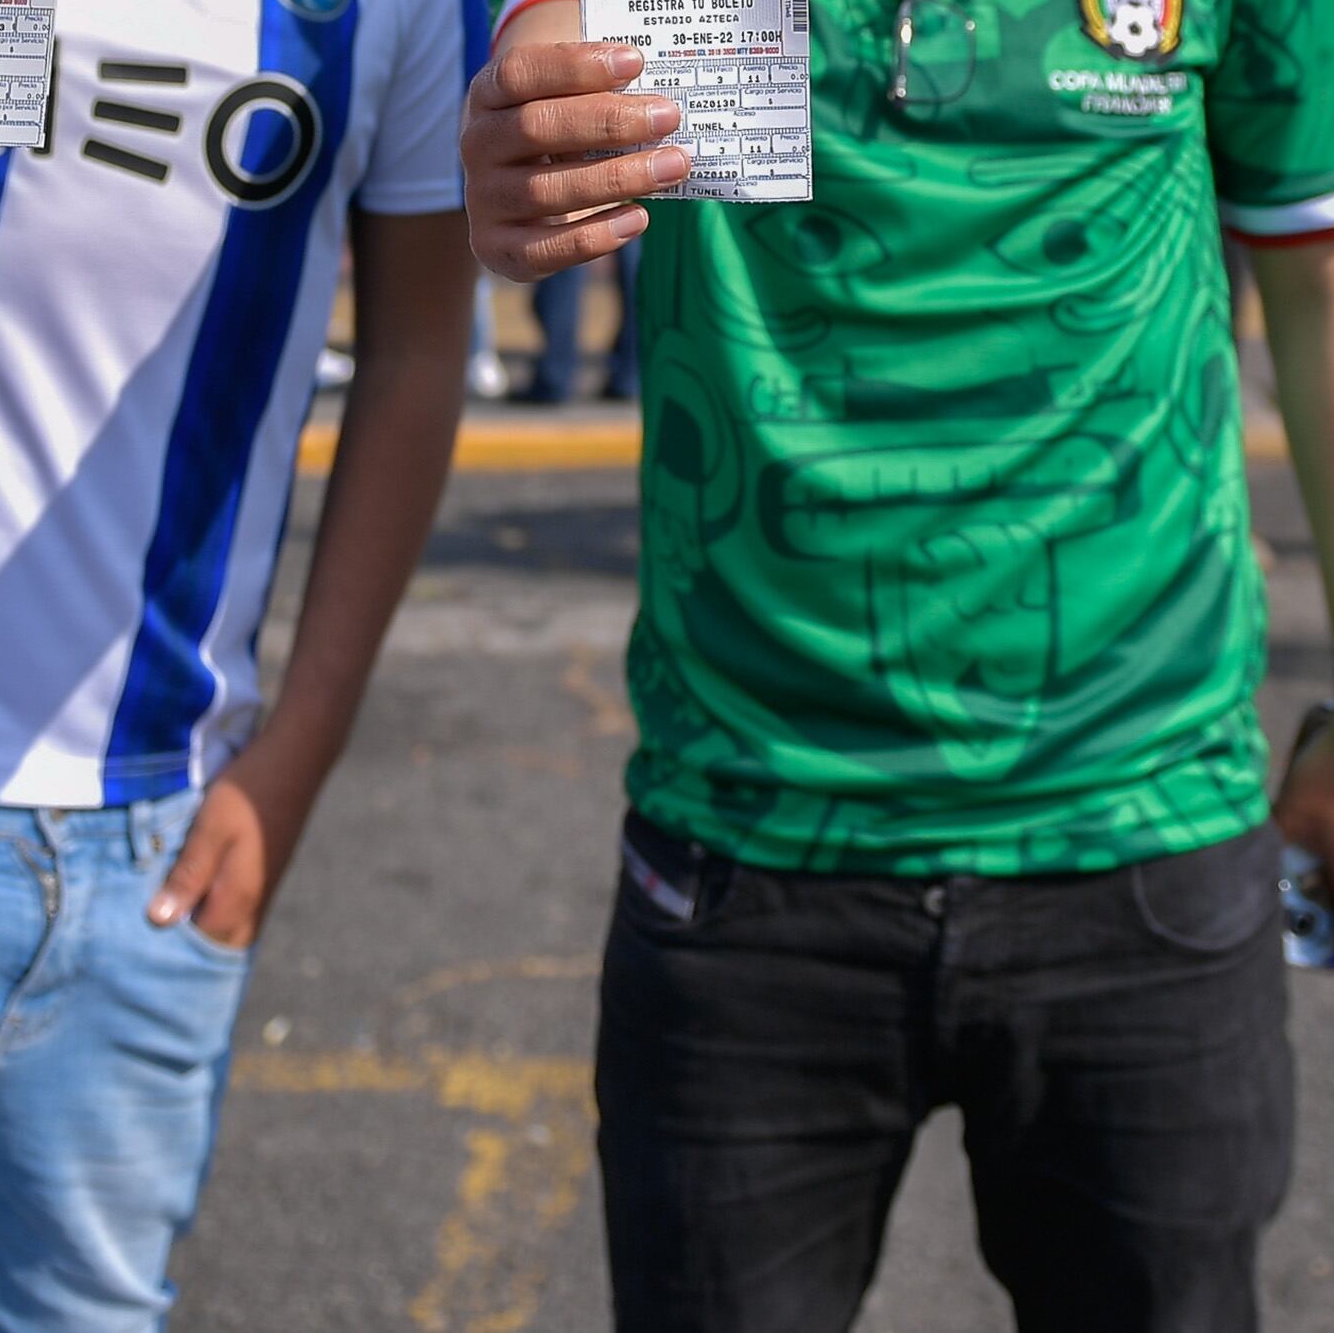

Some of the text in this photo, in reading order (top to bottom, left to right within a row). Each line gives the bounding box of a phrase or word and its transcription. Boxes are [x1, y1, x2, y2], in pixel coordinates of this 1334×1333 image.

[643, 14, 739, 26] ESTADIO AZTECA
[672, 32, 733, 46] 30-ENE-22
[740, 30, 782, 44] 17:00H
[653, 78, 680, 86] AC12
[717, 76, 724, 84] 3
[747, 74, 761, 83] 11
[689, 100, 736, 109] EAZ0130
[29, 51, 319, 204] EO
[692, 122, 737, 131] TUNEL 4
[719, 146, 725, 154] 3
[689, 170, 738, 179] EAZ0130
[691, 188, 739, 197] TUNEL 4
